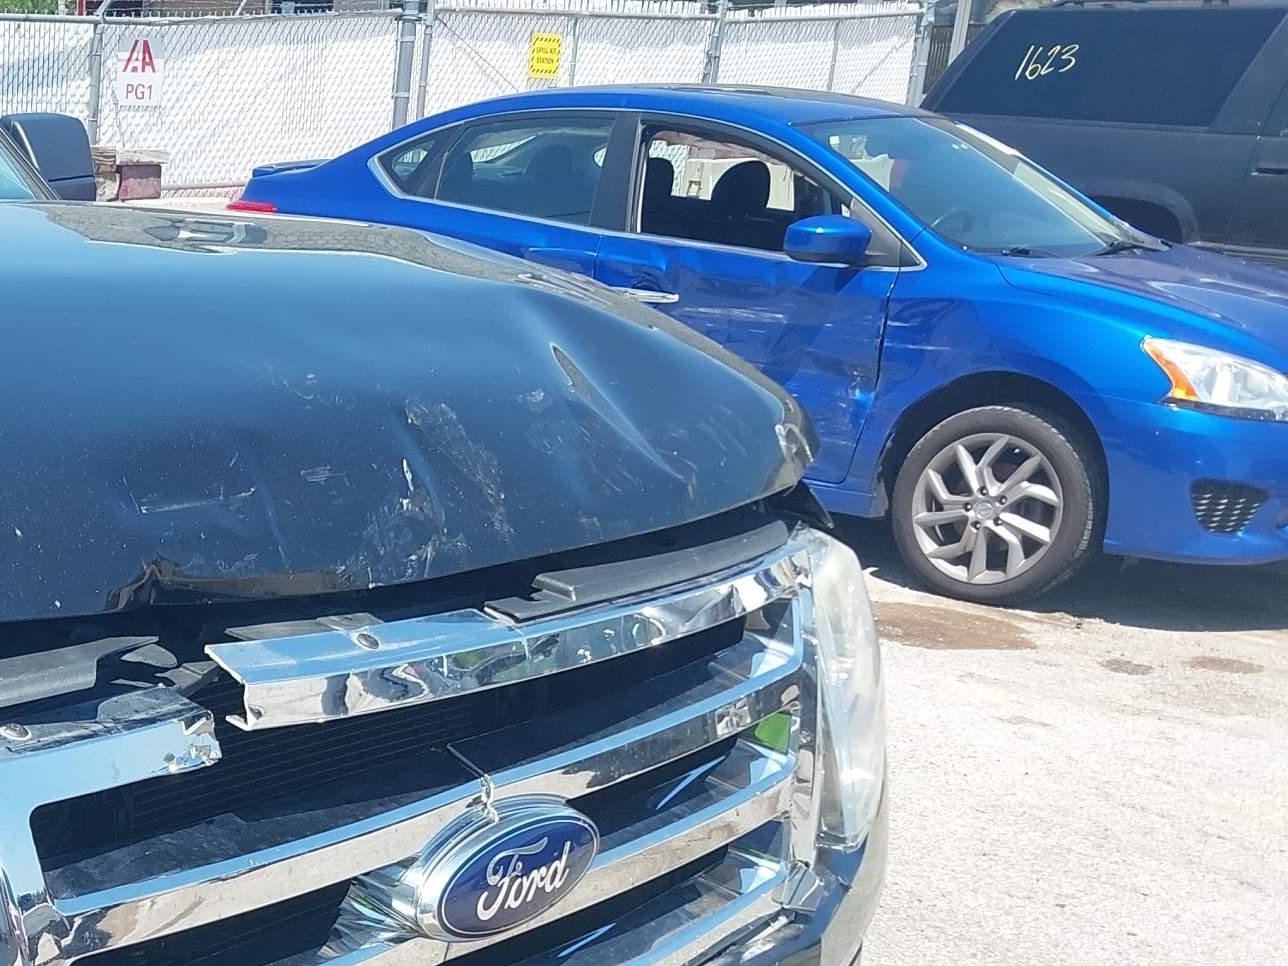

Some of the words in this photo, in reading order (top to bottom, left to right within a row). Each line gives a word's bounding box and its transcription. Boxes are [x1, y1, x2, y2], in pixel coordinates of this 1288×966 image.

[1014, 44, 1080, 80] 1623
[125, 83, 153, 100] PG1
[477, 837, 572, 920] Ford
